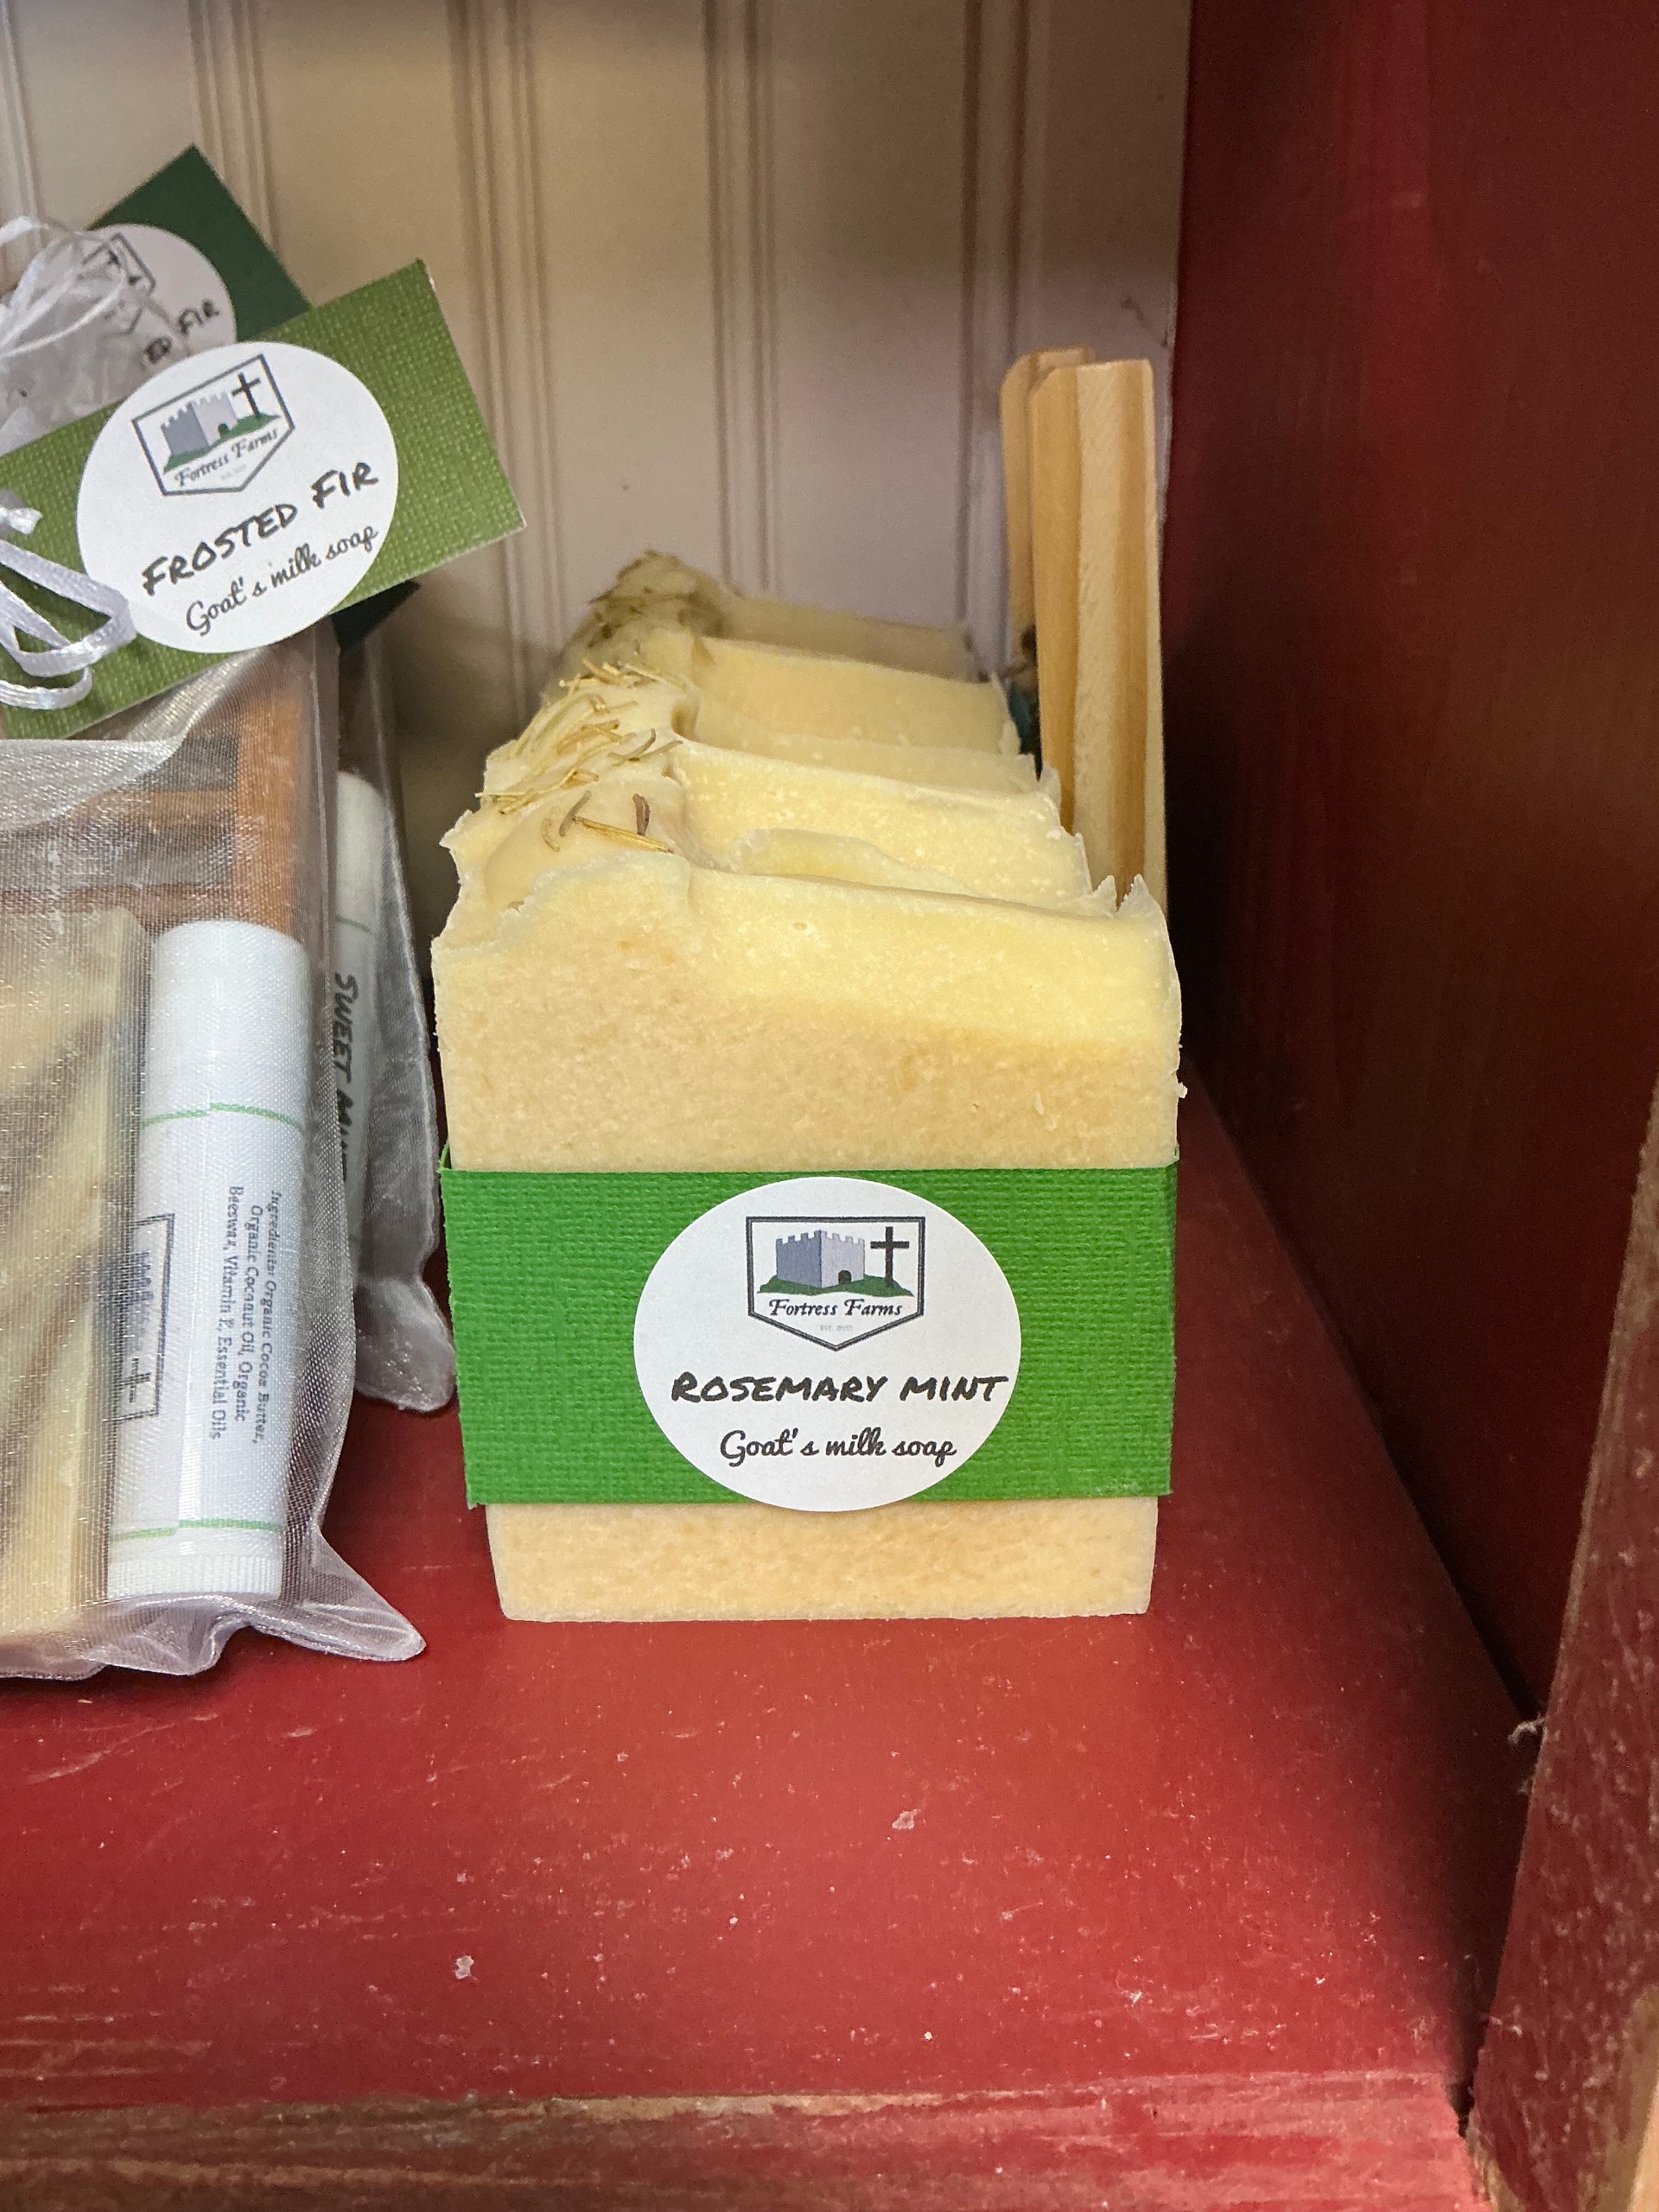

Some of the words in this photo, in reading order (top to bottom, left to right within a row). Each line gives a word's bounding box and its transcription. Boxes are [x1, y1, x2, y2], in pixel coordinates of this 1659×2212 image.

[175, 454, 230, 487] Fortress
[231, 429, 278, 459] Farms
[142, 503, 298, 596] FROSTED
[310, 461, 379, 509] FIR
[186, 576, 268, 637] Goat's
[270, 543, 322, 588] milk
[325, 524, 379, 561] soap
[332, 970, 359, 1085] SWEET
[244, 1205, 263, 1262] Organic
[219, 1255, 238, 1314] Vitamin
[242, 1266, 259, 1328] Coconut
[259, 1280, 277, 1339] Organic
[768, 1298, 838, 1317] Fortress
[843, 1298, 903, 1317] Farms
[213, 1336, 232, 1405] Essential
[238, 1331, 255, 1357] Oil,
[232, 1361, 253, 1422] Organic
[671, 1370, 889, 1404] ROSEMARY
[899, 1375, 1010, 1402] MINT
[209, 1408, 226, 1440] Oils
[719, 1427, 820, 1467] Goat's
[824, 1426, 887, 1457] milk
[891, 1436, 957, 1467] soap
